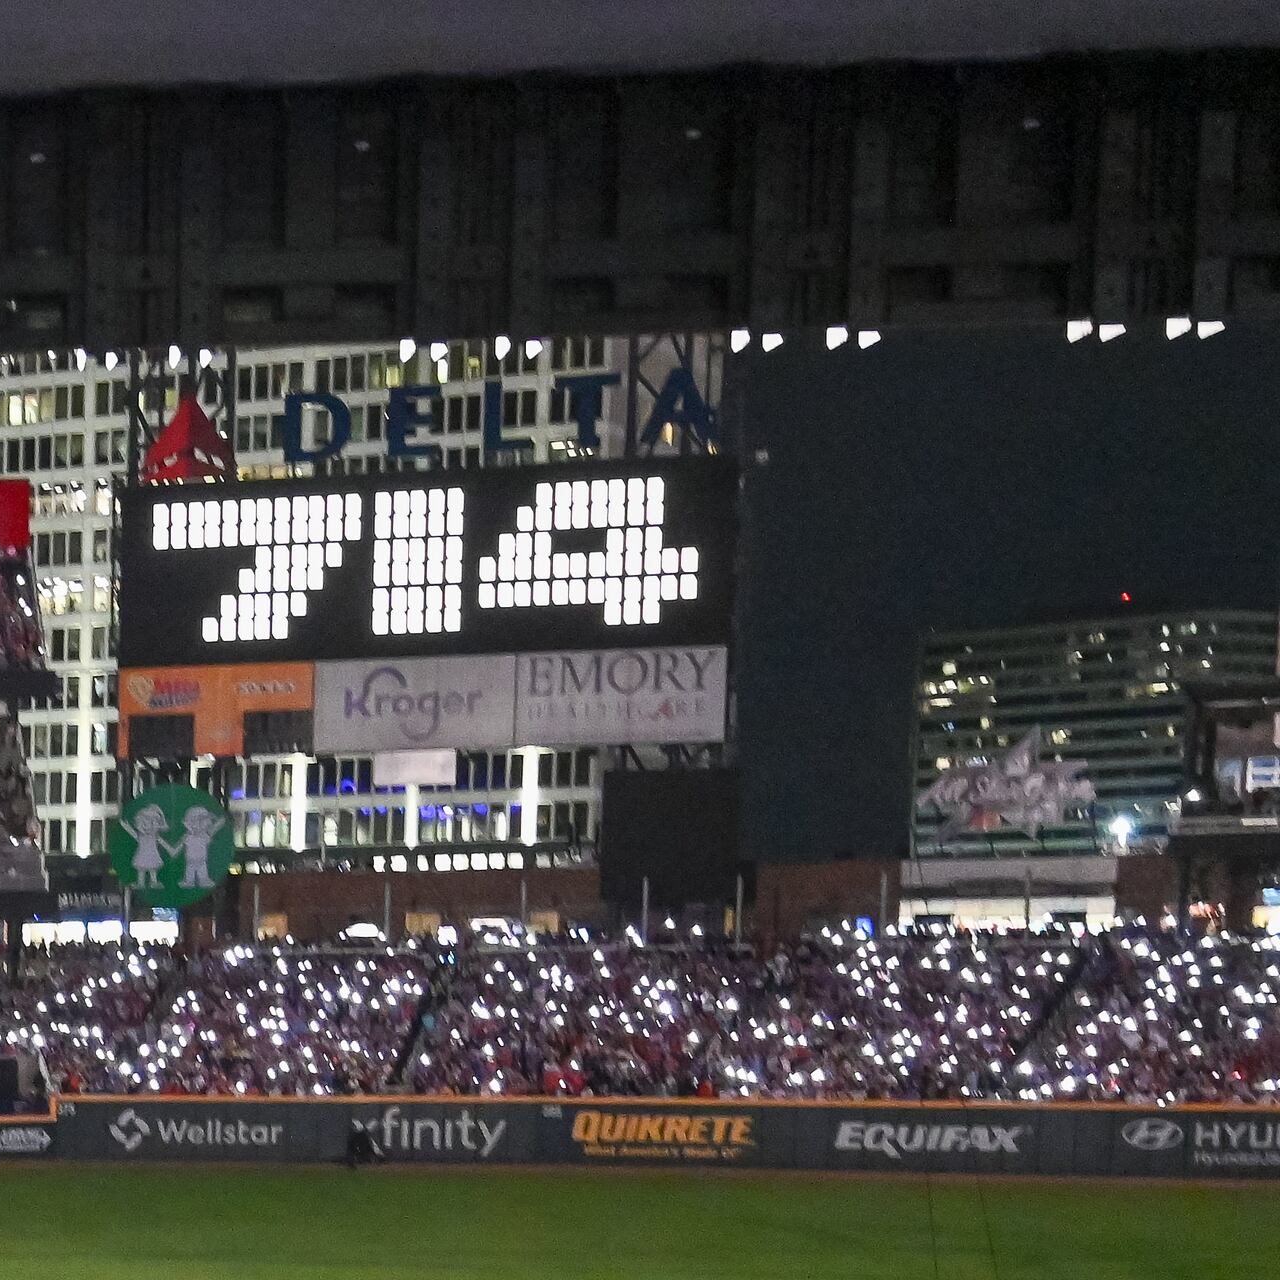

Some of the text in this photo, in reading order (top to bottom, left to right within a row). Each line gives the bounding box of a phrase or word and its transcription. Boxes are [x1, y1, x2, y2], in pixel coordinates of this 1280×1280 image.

[285, 367, 717, 462] DELTA
[152, 477, 699, 643] 714
[529, 650, 718, 696] EMORY
[344, 667, 483, 741] Kroger
[156, 1117, 283, 1146] Wellstar
[572, 1110, 757, 1145] QUIKRETE
[835, 1120, 1022, 1158] EQUIFAX
[1195, 1121, 1280, 1150] HYU
